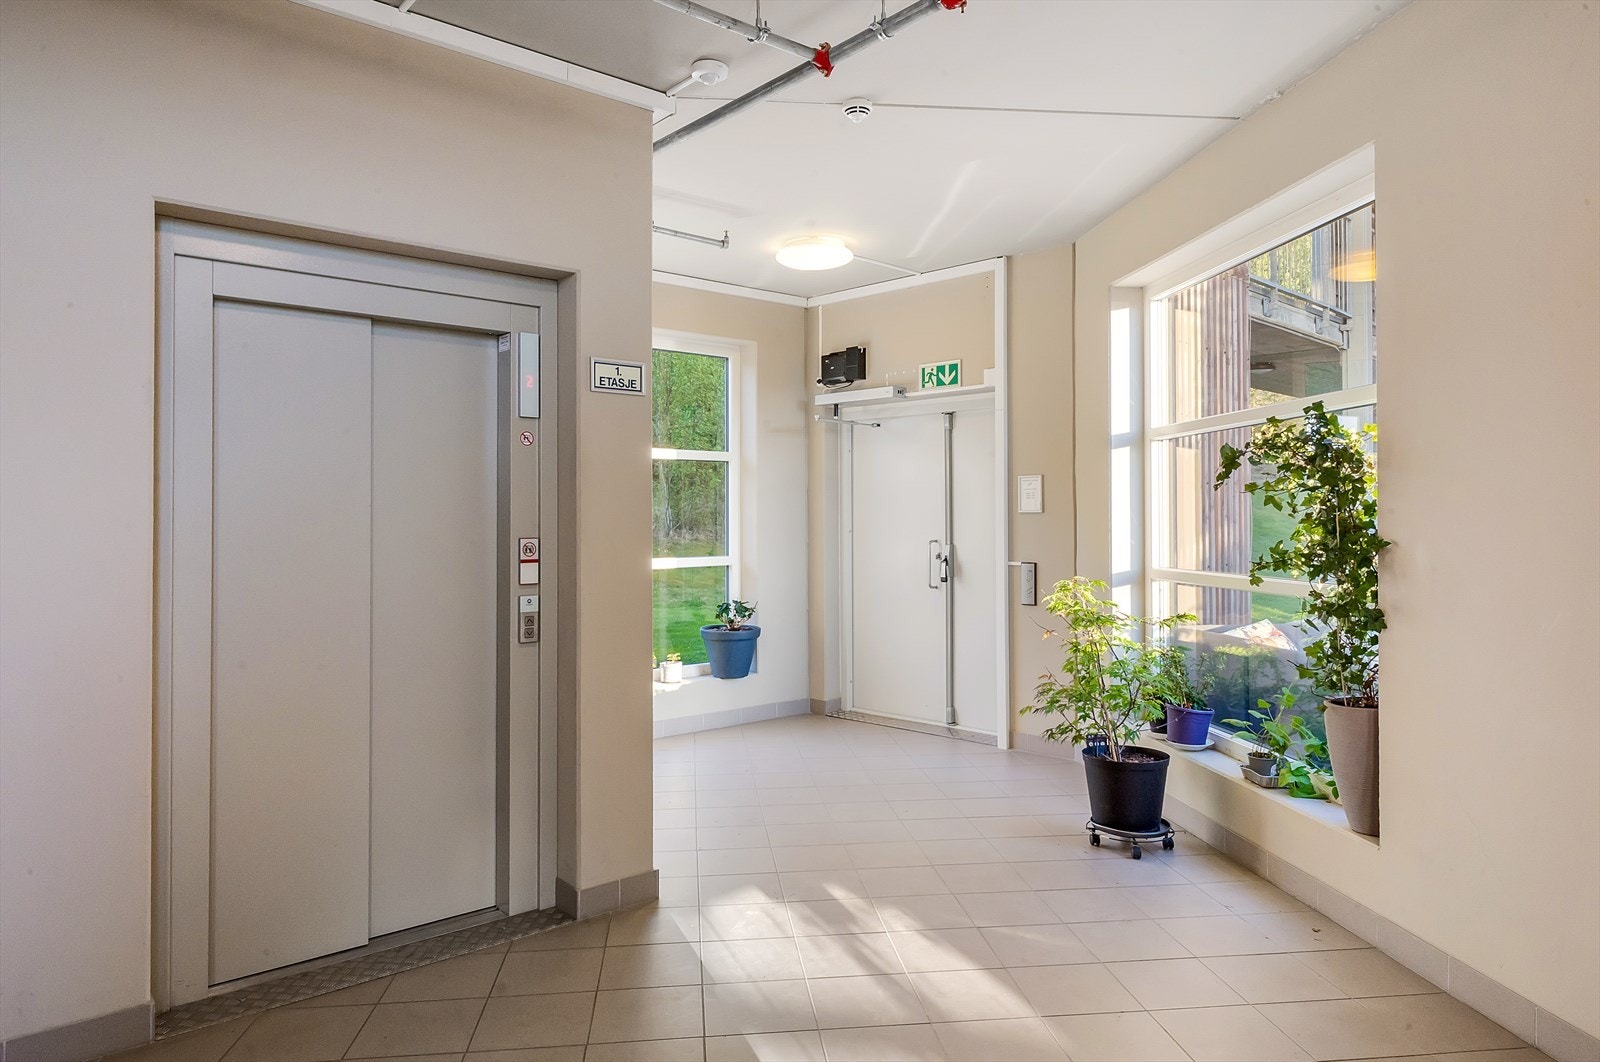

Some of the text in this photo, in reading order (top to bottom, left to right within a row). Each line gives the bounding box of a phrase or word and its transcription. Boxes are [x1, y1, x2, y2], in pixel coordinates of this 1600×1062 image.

[615, 366, 622, 376] 1.
[526, 374, 533, 388] 2
[599, 376, 637, 389] ETASJE
